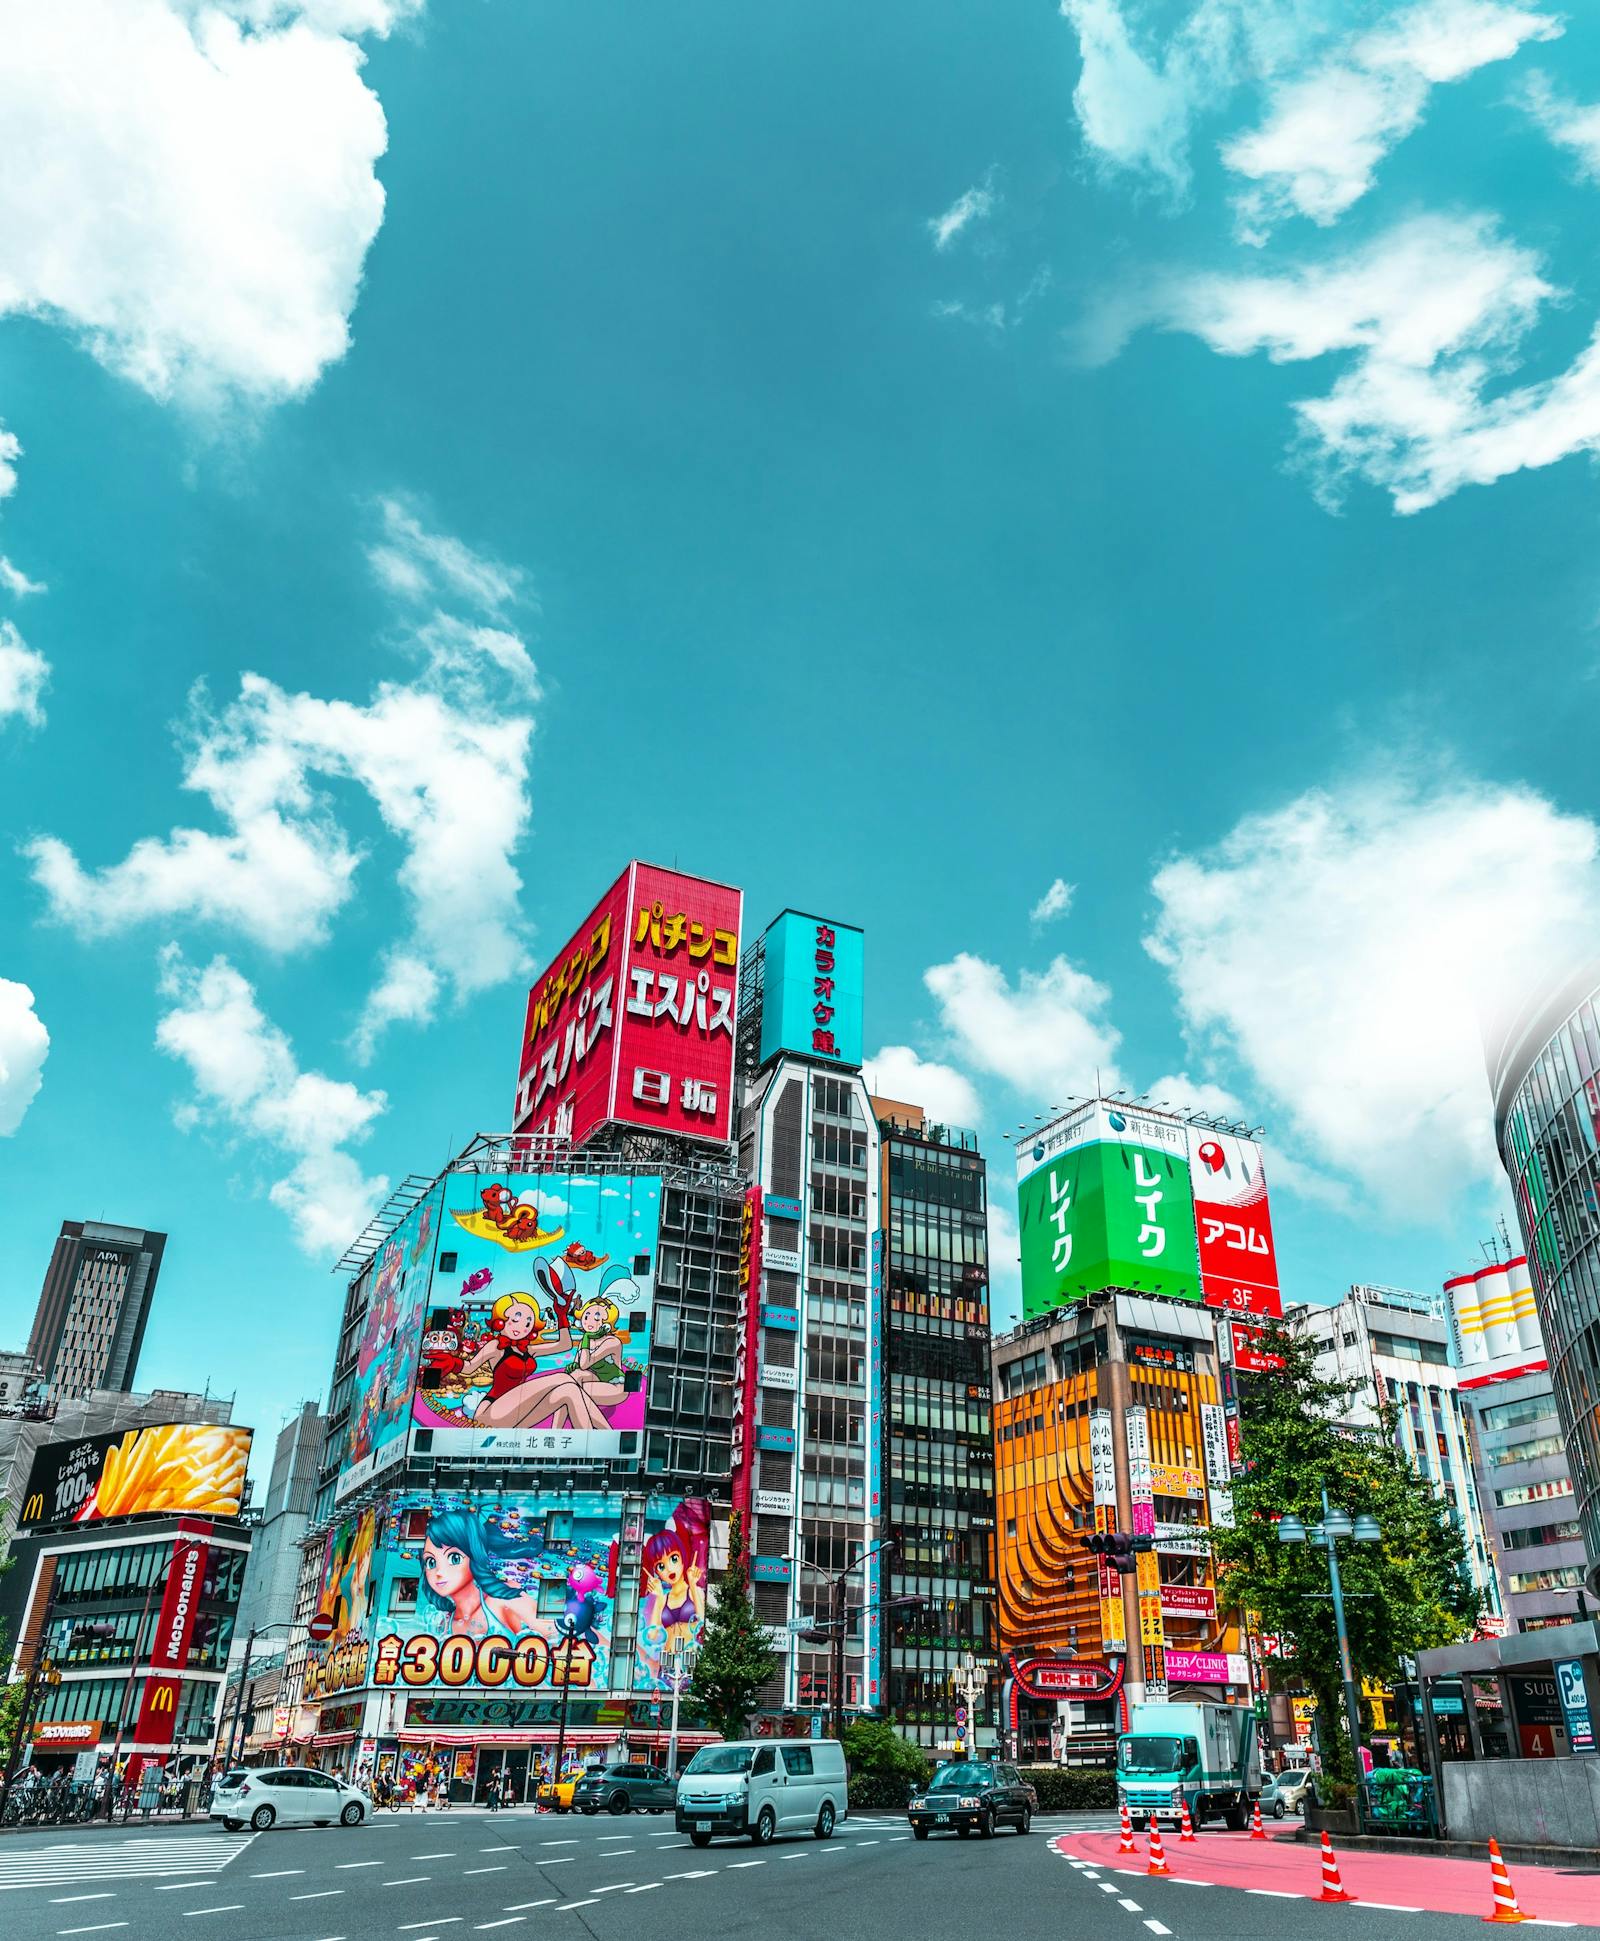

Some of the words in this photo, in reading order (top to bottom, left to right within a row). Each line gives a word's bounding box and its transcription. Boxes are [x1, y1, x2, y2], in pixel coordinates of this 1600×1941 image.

[634, 900, 737, 966] パチンコ
[528, 912, 611, 1043] パチンコ
[626, 966, 733, 1036] エスパス
[514, 973, 613, 1131] エスパス
[632, 1066, 717, 1115] 日拓
[1130, 1120, 1178, 1143] 新生銀行
[1049, 1170, 1073, 1273] レイク
[1133, 1153, 1166, 1257] レイク
[1202, 1217, 1270, 1255] アコム
[97, 1251, 119, 1262] APA
[1232, 1288, 1253, 1306] 3F
[1448, 1291, 1456, 1316] Don
[68, 1442, 93, 1461] まるごと
[526, 1436, 573, 1449] 北電子
[1101, 1424, 1114, 1492] 小松ビル
[58, 1451, 100, 1480] じゃがいも
[55, 1472, 96, 1512] 100%
[1171, 1594, 1195, 1604] Corner
[1197, 1596, 1208, 1605] 117
[1560, 1671, 1574, 1705] P
[1531, 1734, 1545, 1756] 4
